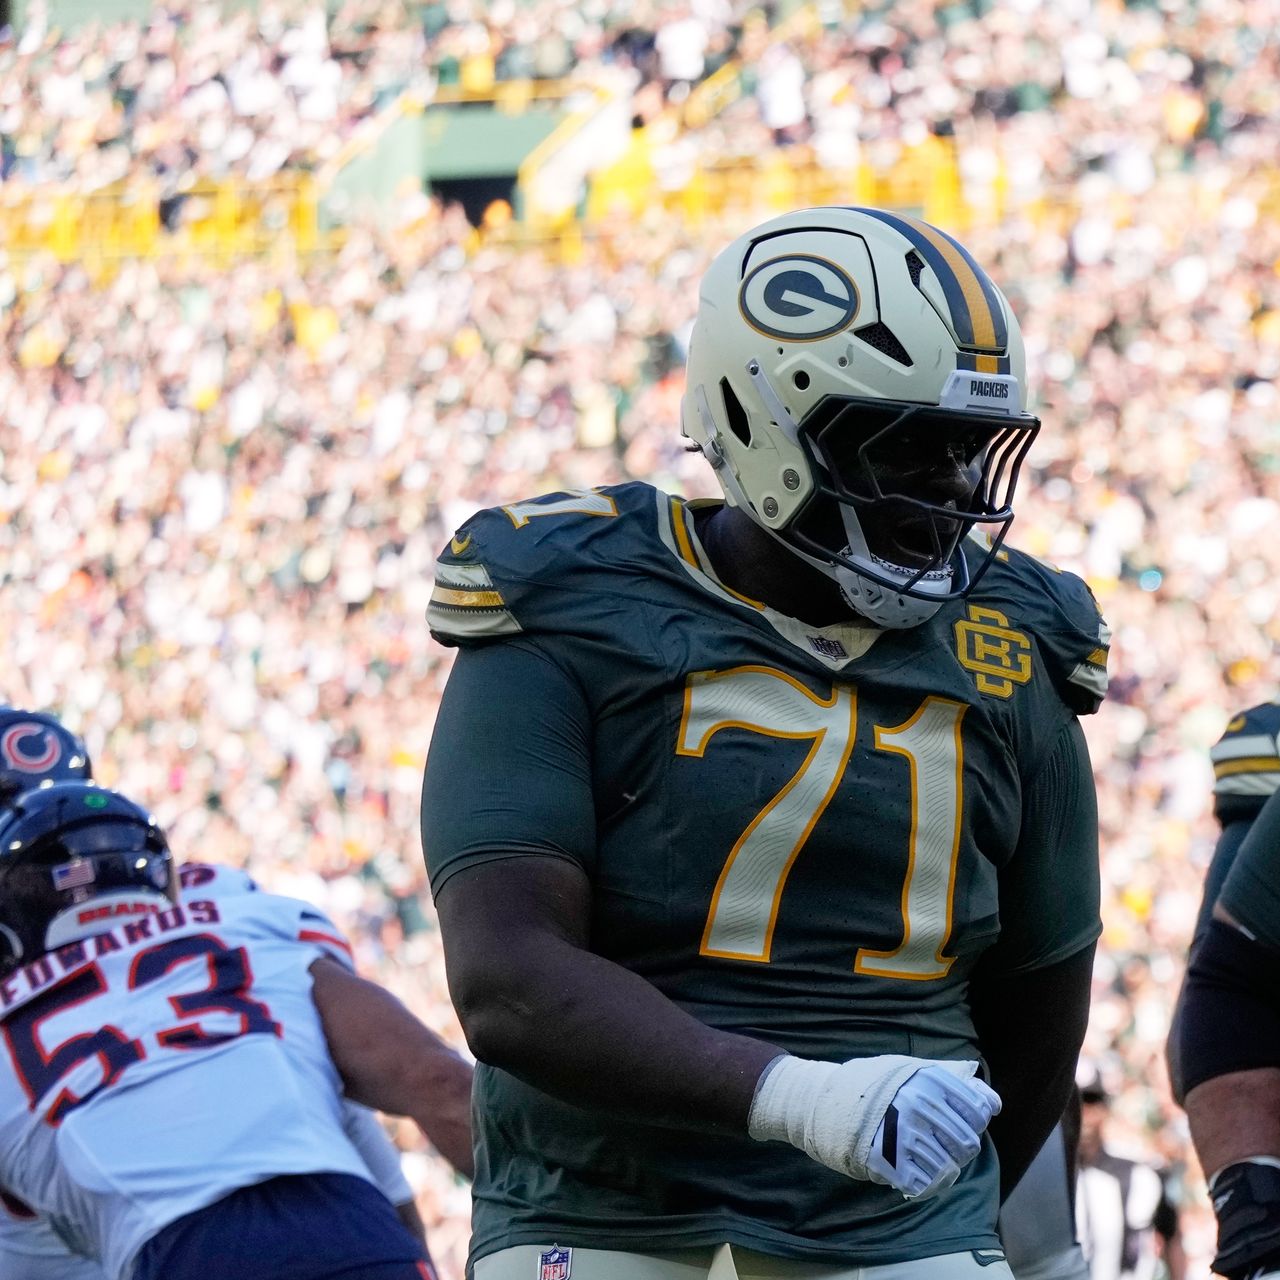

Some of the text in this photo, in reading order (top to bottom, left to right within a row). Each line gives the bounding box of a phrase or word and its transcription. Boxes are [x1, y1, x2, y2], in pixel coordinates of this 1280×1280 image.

[970, 380, 1009, 399] PACKERS
[676, 665, 970, 981] 71
[1, 931, 283, 1128] 53
